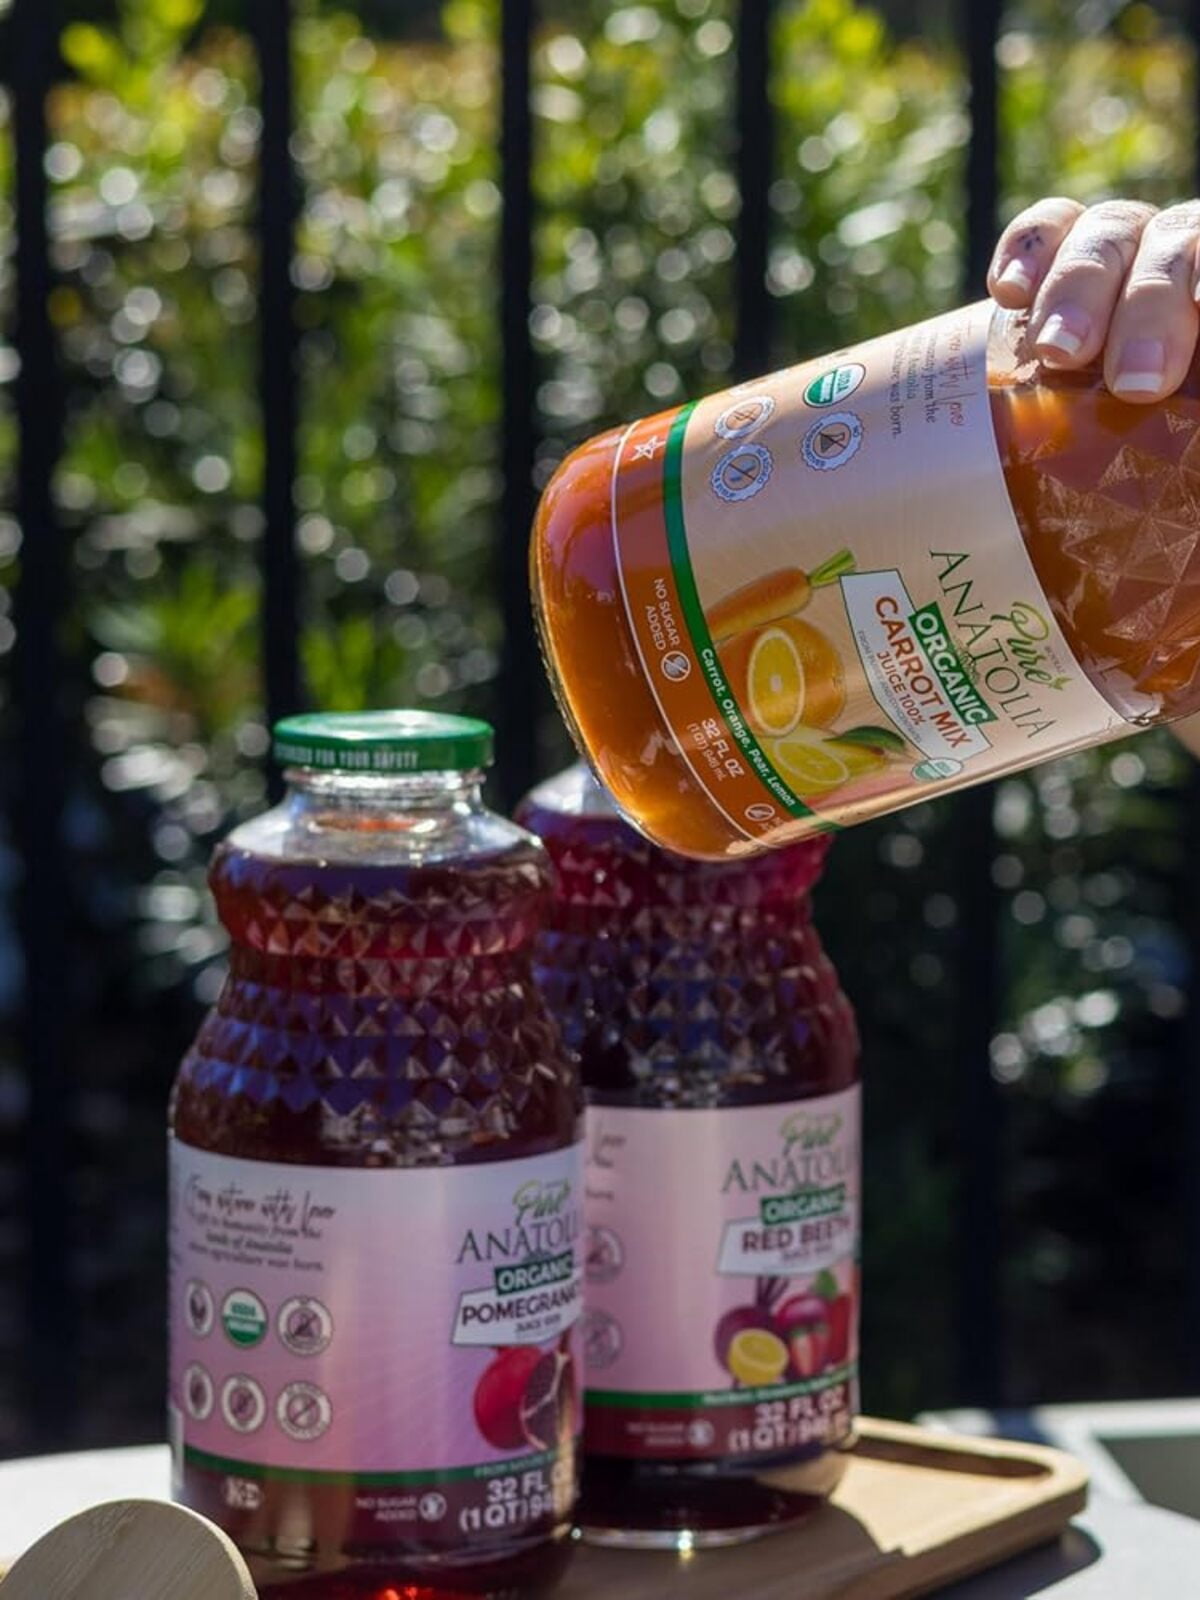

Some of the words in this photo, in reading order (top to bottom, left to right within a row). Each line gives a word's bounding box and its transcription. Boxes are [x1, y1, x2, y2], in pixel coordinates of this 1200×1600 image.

[924, 400, 939, 423] the
[653, 578, 668, 600] NO
[645, 604, 667, 650] ADDED
[659, 599, 682, 647] SUGAR
[929, 550, 1056, 739] ANATOLIA
[990, 601, 1053, 687] Pure
[875, 596, 944, 707] CARROT
[930, 710, 973, 749] MIX
[876, 651, 904, 694] JUICE
[899, 694, 928, 727] 100%
[915, 611, 989, 725] ORGANIC
[701, 648, 724, 697] Carrot,
[722, 699, 751, 748] Orange,
[748, 748, 770, 777] Pear,
[767, 775, 797, 808] Lemon
[702, 718, 717, 739] 32
[713, 738, 731, 759] FL
[724, 758, 745, 779] OZ
[742, 1226, 793, 1252] RED
[487, 1477, 517, 1502] 32
[522, 1471, 548, 1494] FL
